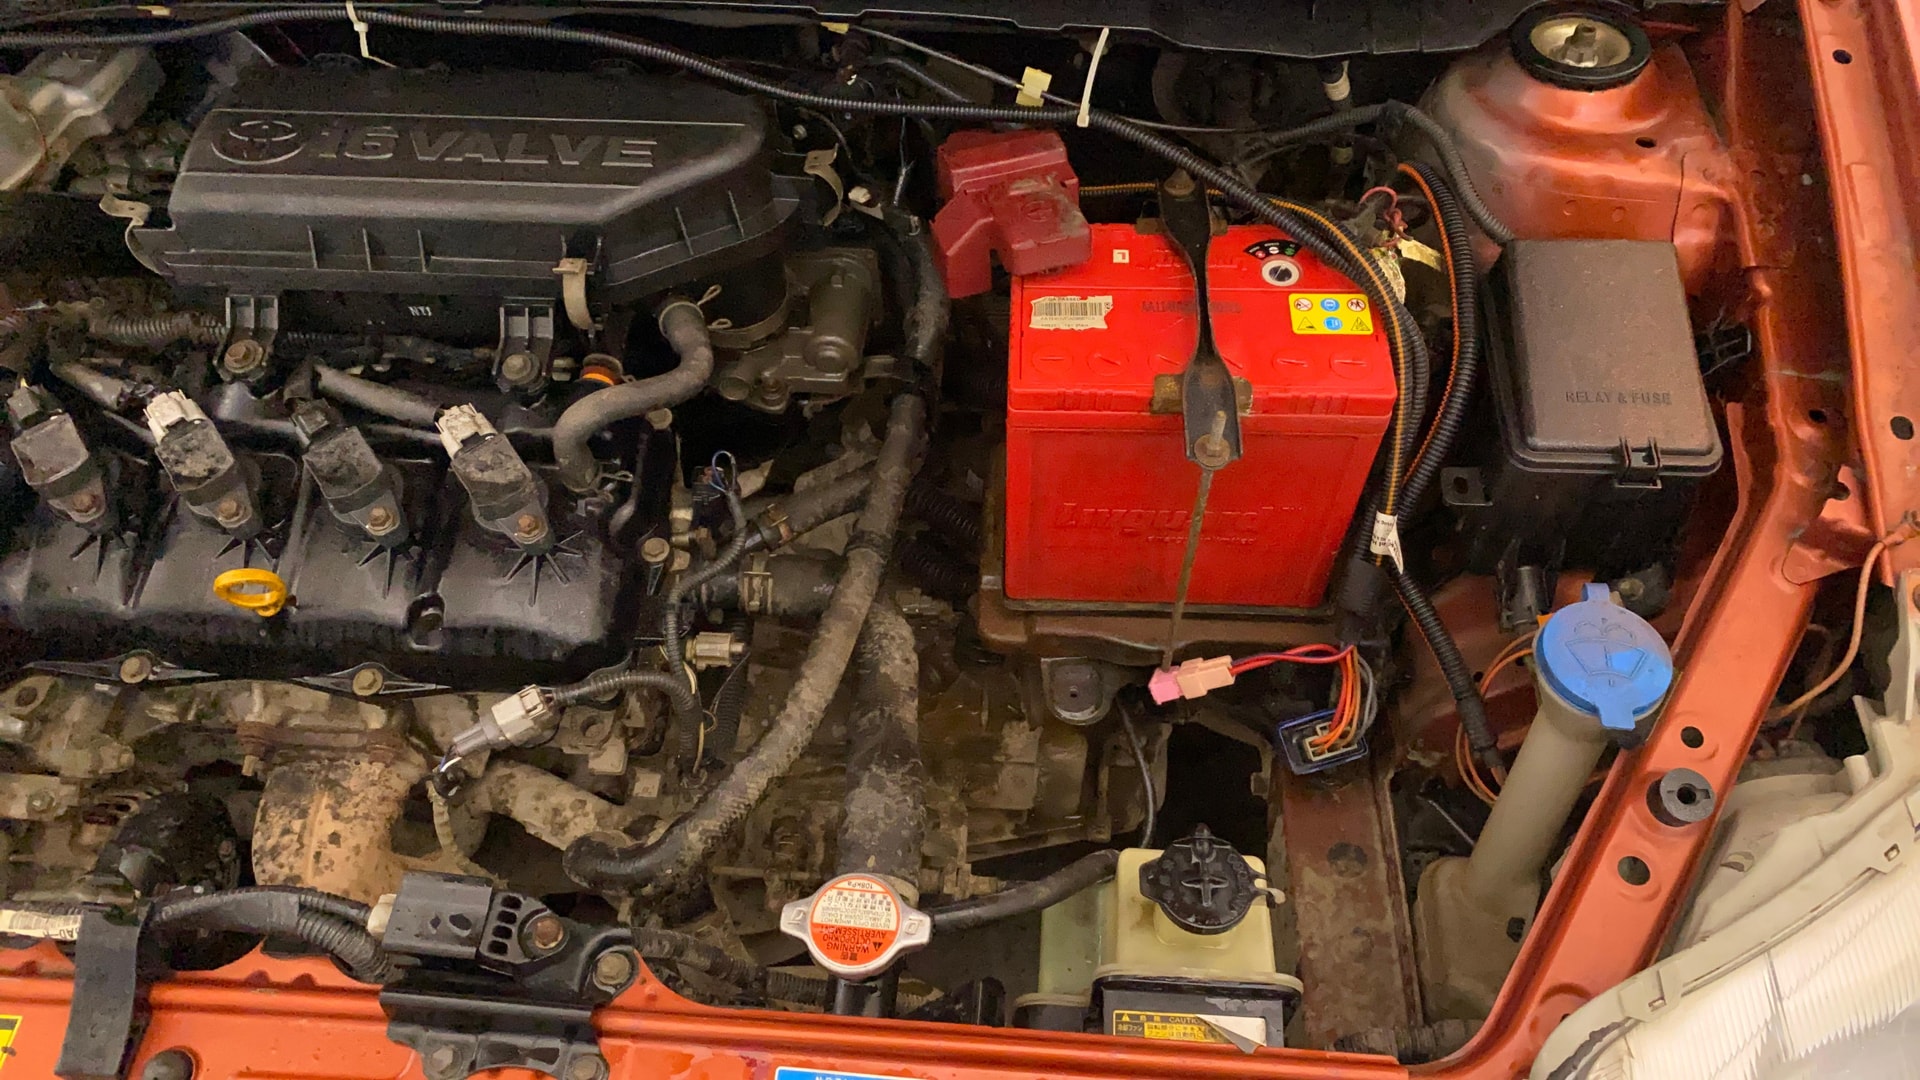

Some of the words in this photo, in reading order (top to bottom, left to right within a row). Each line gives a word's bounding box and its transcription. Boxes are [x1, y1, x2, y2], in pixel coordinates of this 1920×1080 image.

[1565, 391, 1611, 403] RELAY
[1618, 391, 1627, 404] &
[1631, 392, 1673, 405] FUSE
[826, 942, 870, 954] WARNING
